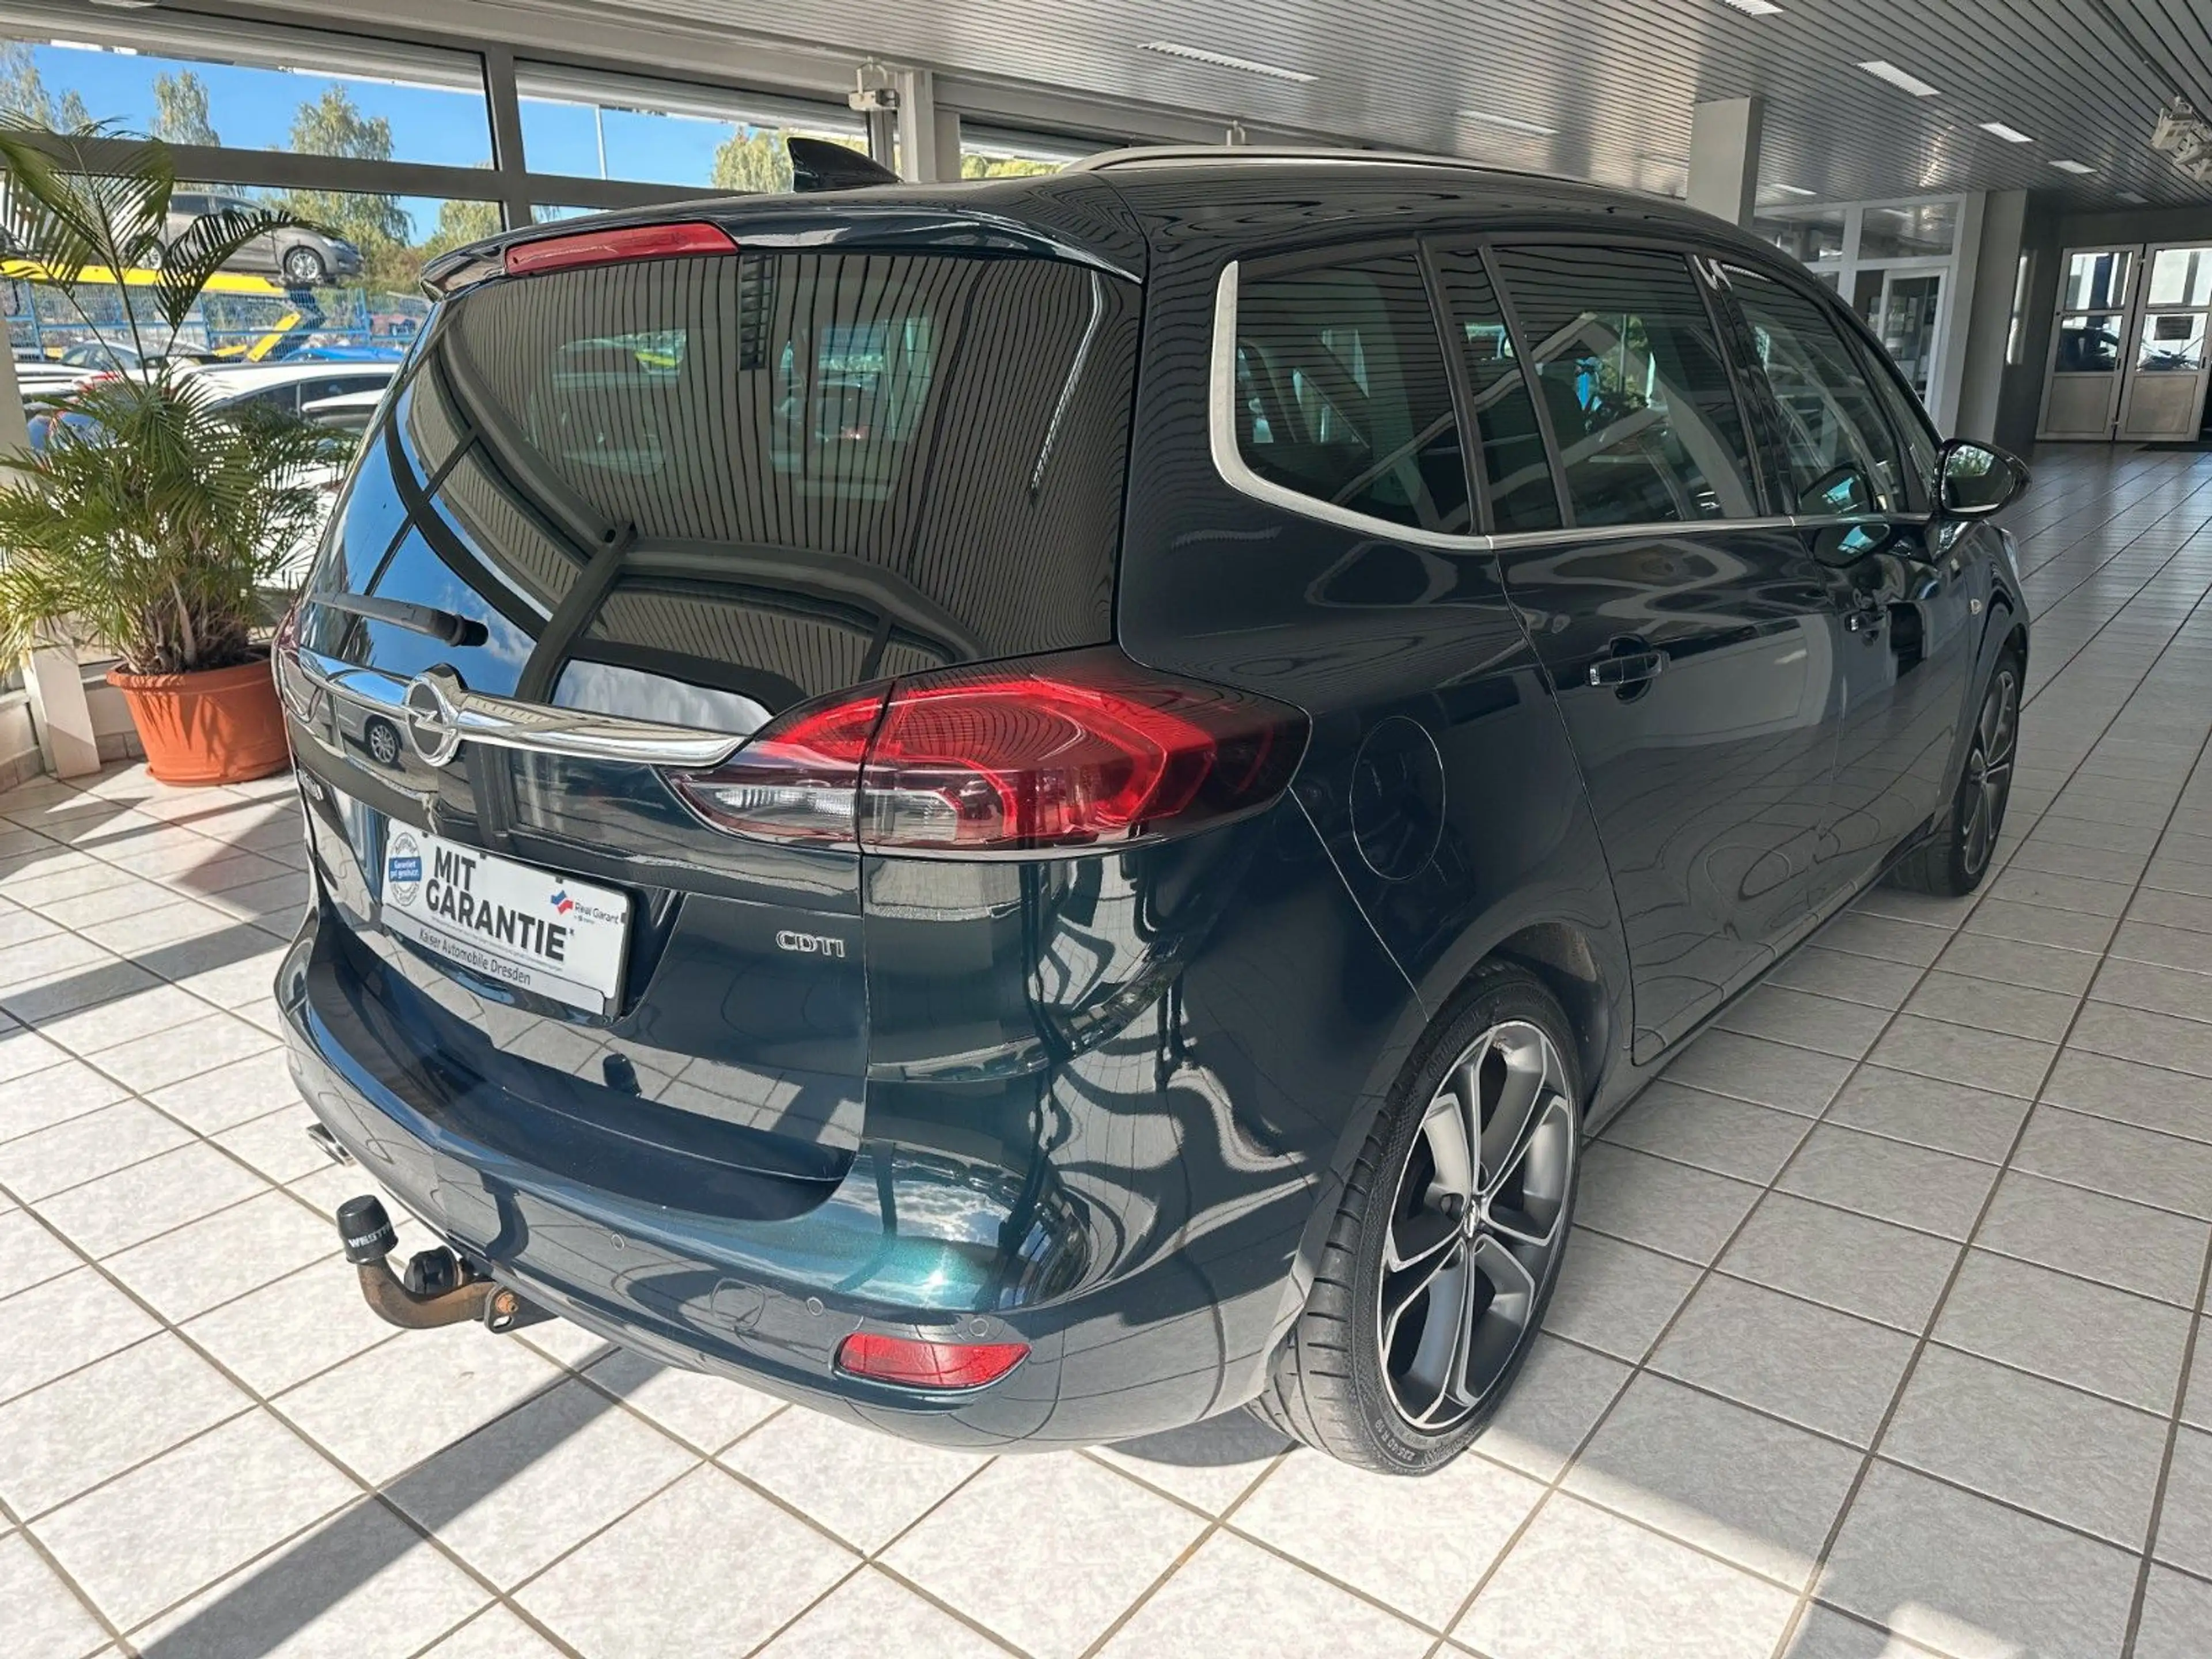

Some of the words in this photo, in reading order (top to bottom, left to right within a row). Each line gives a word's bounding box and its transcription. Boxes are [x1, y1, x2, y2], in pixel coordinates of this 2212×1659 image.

[434, 846, 476, 891] MIT
[442, 938, 488, 971] Automobile
[490, 959, 531, 986] Dresden
